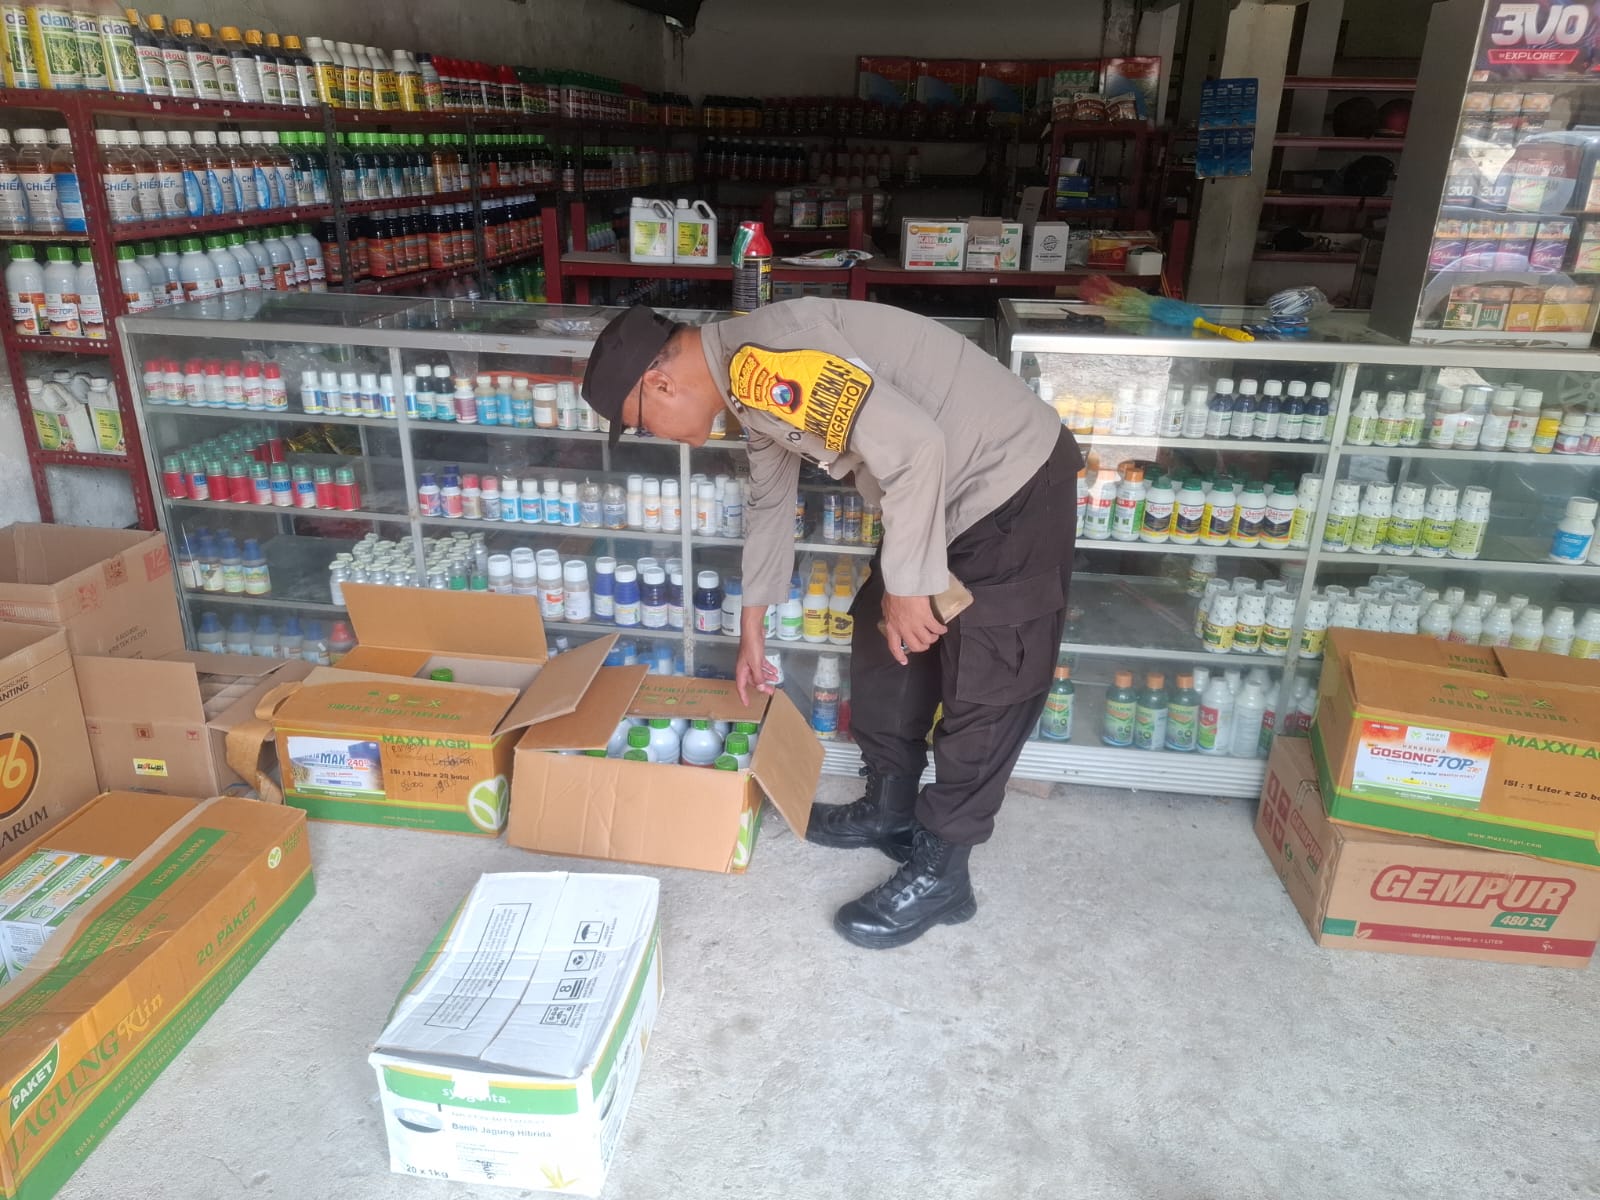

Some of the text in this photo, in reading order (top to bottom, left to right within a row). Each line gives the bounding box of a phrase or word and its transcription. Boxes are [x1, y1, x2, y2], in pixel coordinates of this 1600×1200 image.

[0, 182, 21, 191] HIEF
[104, 182, 133, 191] CHIEF
[382, 735, 430, 747] MAXXI
[435, 738, 471, 750] AGRI
[1507, 733, 1577, 756] MAXXI
[1503, 779, 1518, 787] ISI
[1537, 784, 1562, 795] Liter
[1574, 790, 1588, 799] 20
[1374, 868, 1571, 911] GEMPUR
[1500, 915, 1548, 928] 480 SL
[196, 898, 258, 966] 20 PAKET
[11, 1059, 54, 1111] PAKET
[451, 1122, 552, 1138] Benih Jagung Hibrida
[405, 1163, 417, 1174] 20
